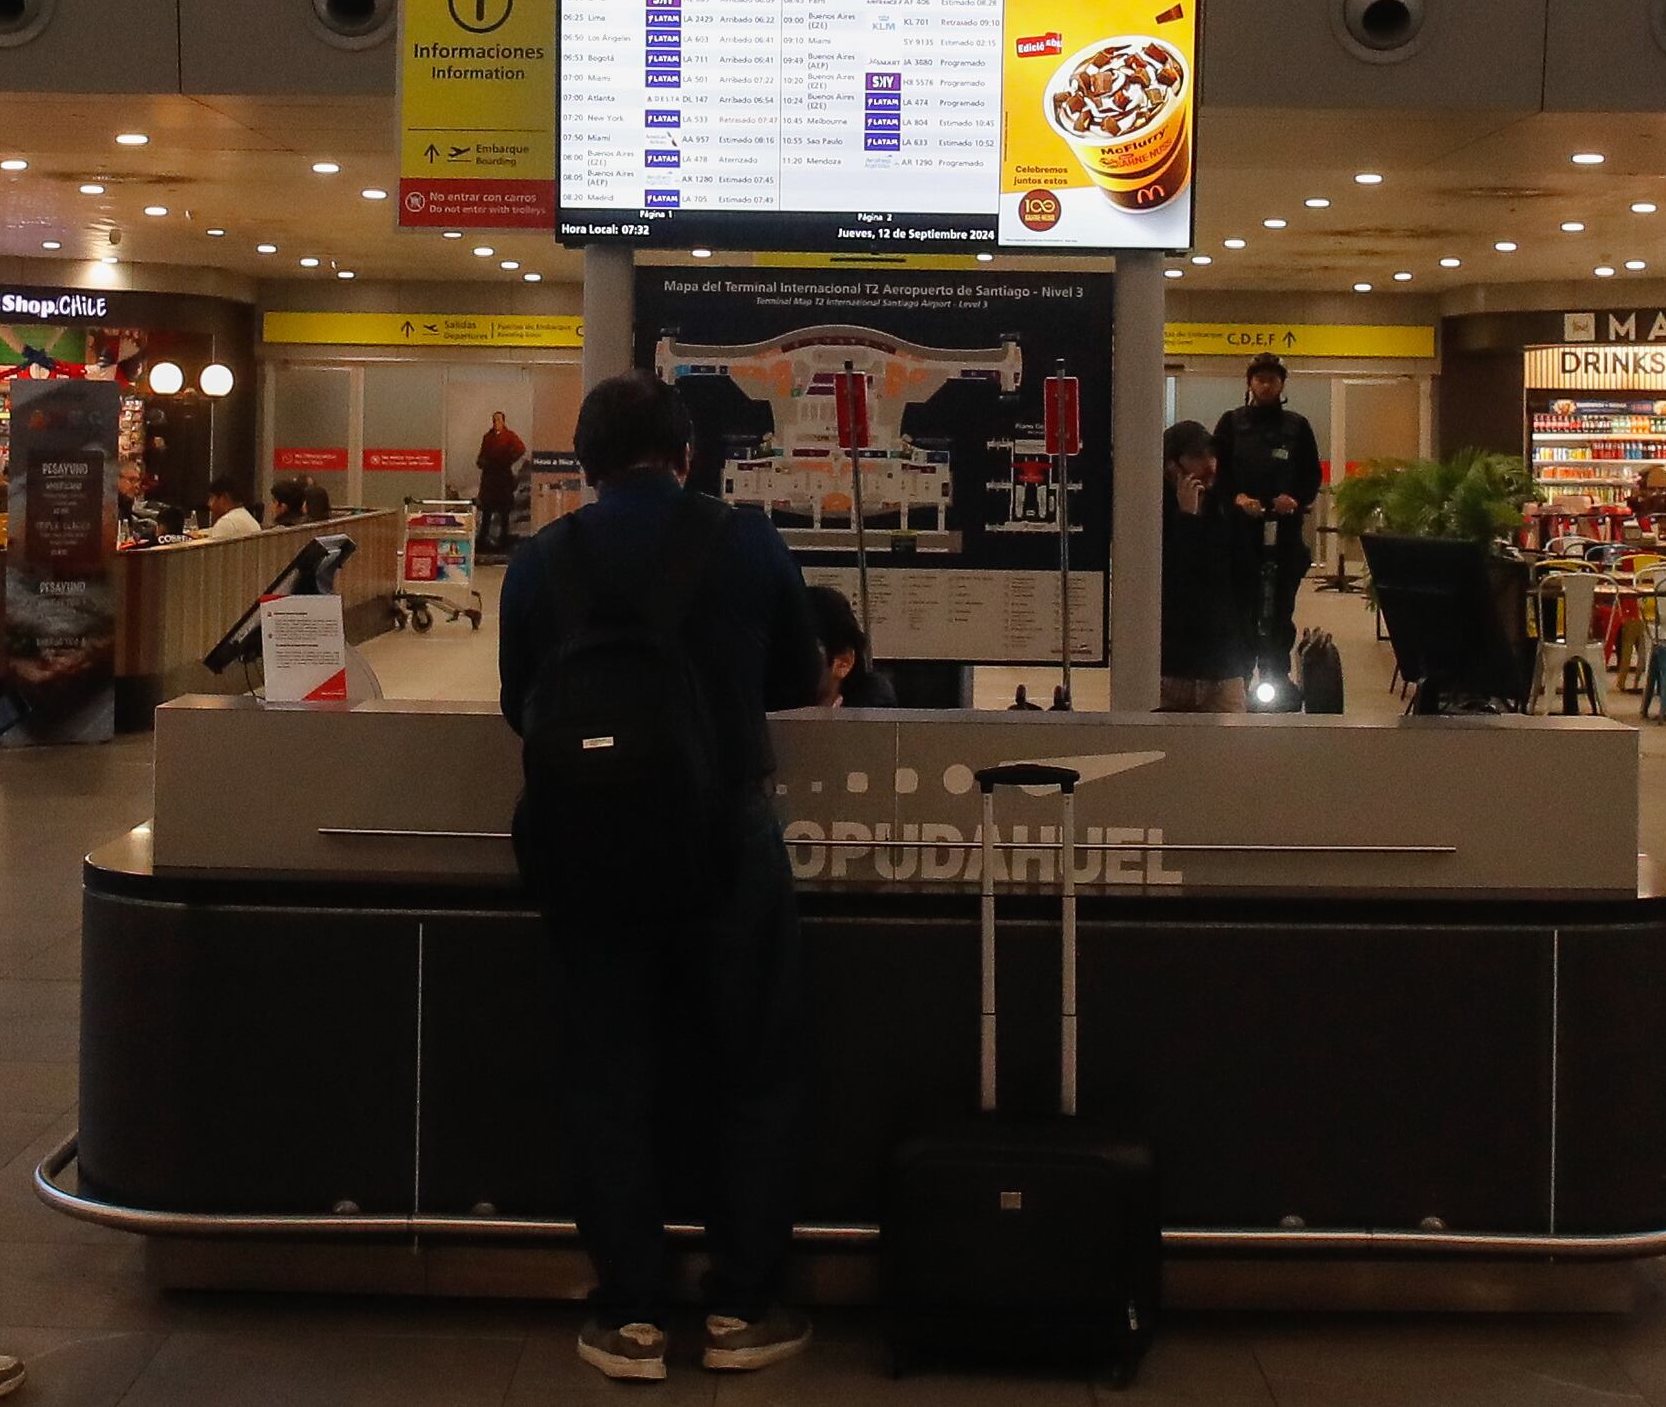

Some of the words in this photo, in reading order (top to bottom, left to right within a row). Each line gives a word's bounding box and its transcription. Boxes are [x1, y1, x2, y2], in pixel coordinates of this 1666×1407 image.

[413, 42, 545, 60] Informaciones
[431, 66, 525, 81] Information
[1101, 129, 1166, 156] McFlurry
[476, 144, 530, 156] Embarque
[1015, 165, 1068, 175] Celebremos
[1013, 176, 1042, 186] juntos
[1044, 177, 1068, 185] estos
[429, 192, 444, 202] No
[447, 193, 480, 202] entrar
[483, 194, 502, 202] con
[504, 195, 537, 203] carros
[561, 224, 587, 235] Hora
[589, 224, 619, 235] Local:
[621, 225, 651, 236] 07:32
[837, 227, 875, 240] Jueves,
[878, 229, 890, 239] 12
[893, 228, 906, 239] de
[908, 229, 967, 242] Septiembre
[969, 230, 995, 240] 2024
[664, 280, 699, 294] Mapa
[702, 280, 722, 292] del
[725, 280, 777, 294] Terminal
[780, 281, 862, 295] Internacional
[864, 282, 880, 294] T2
[882, 283, 954, 298] Aeropuerto
[957, 284, 973, 297] de
[975, 284, 1032, 301] Santiago
[1041, 286, 1074, 299] Nivel
[1076, 286, 1085, 299] 3
[444, 320, 477, 330] Salidas
[1561, 349, 1666, 376] DRINKS
